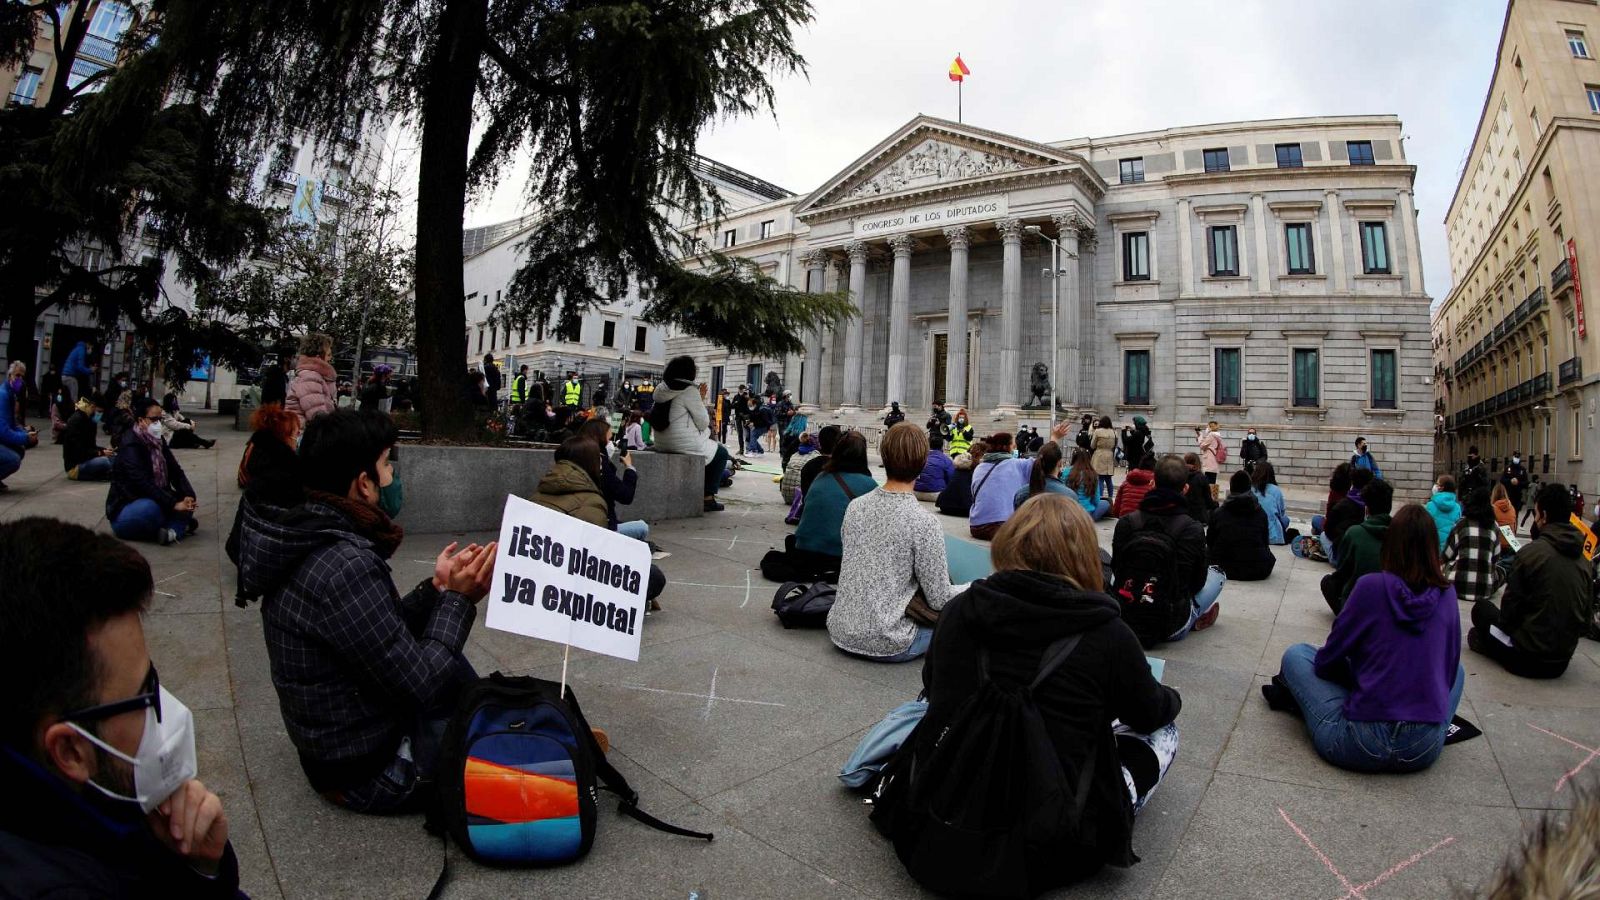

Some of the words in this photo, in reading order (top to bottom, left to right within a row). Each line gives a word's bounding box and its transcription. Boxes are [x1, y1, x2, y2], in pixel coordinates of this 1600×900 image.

[862, 217, 904, 232] CONGRESO
[909, 215, 920, 224] DE
[925, 211, 941, 222] LOS
[946, 202, 997, 218] DIPUTADOS
[508, 525, 565, 567] ¡Este
[568, 546, 641, 595] planeta
[501, 572, 537, 606] ya
[541, 584, 637, 635] explota!
